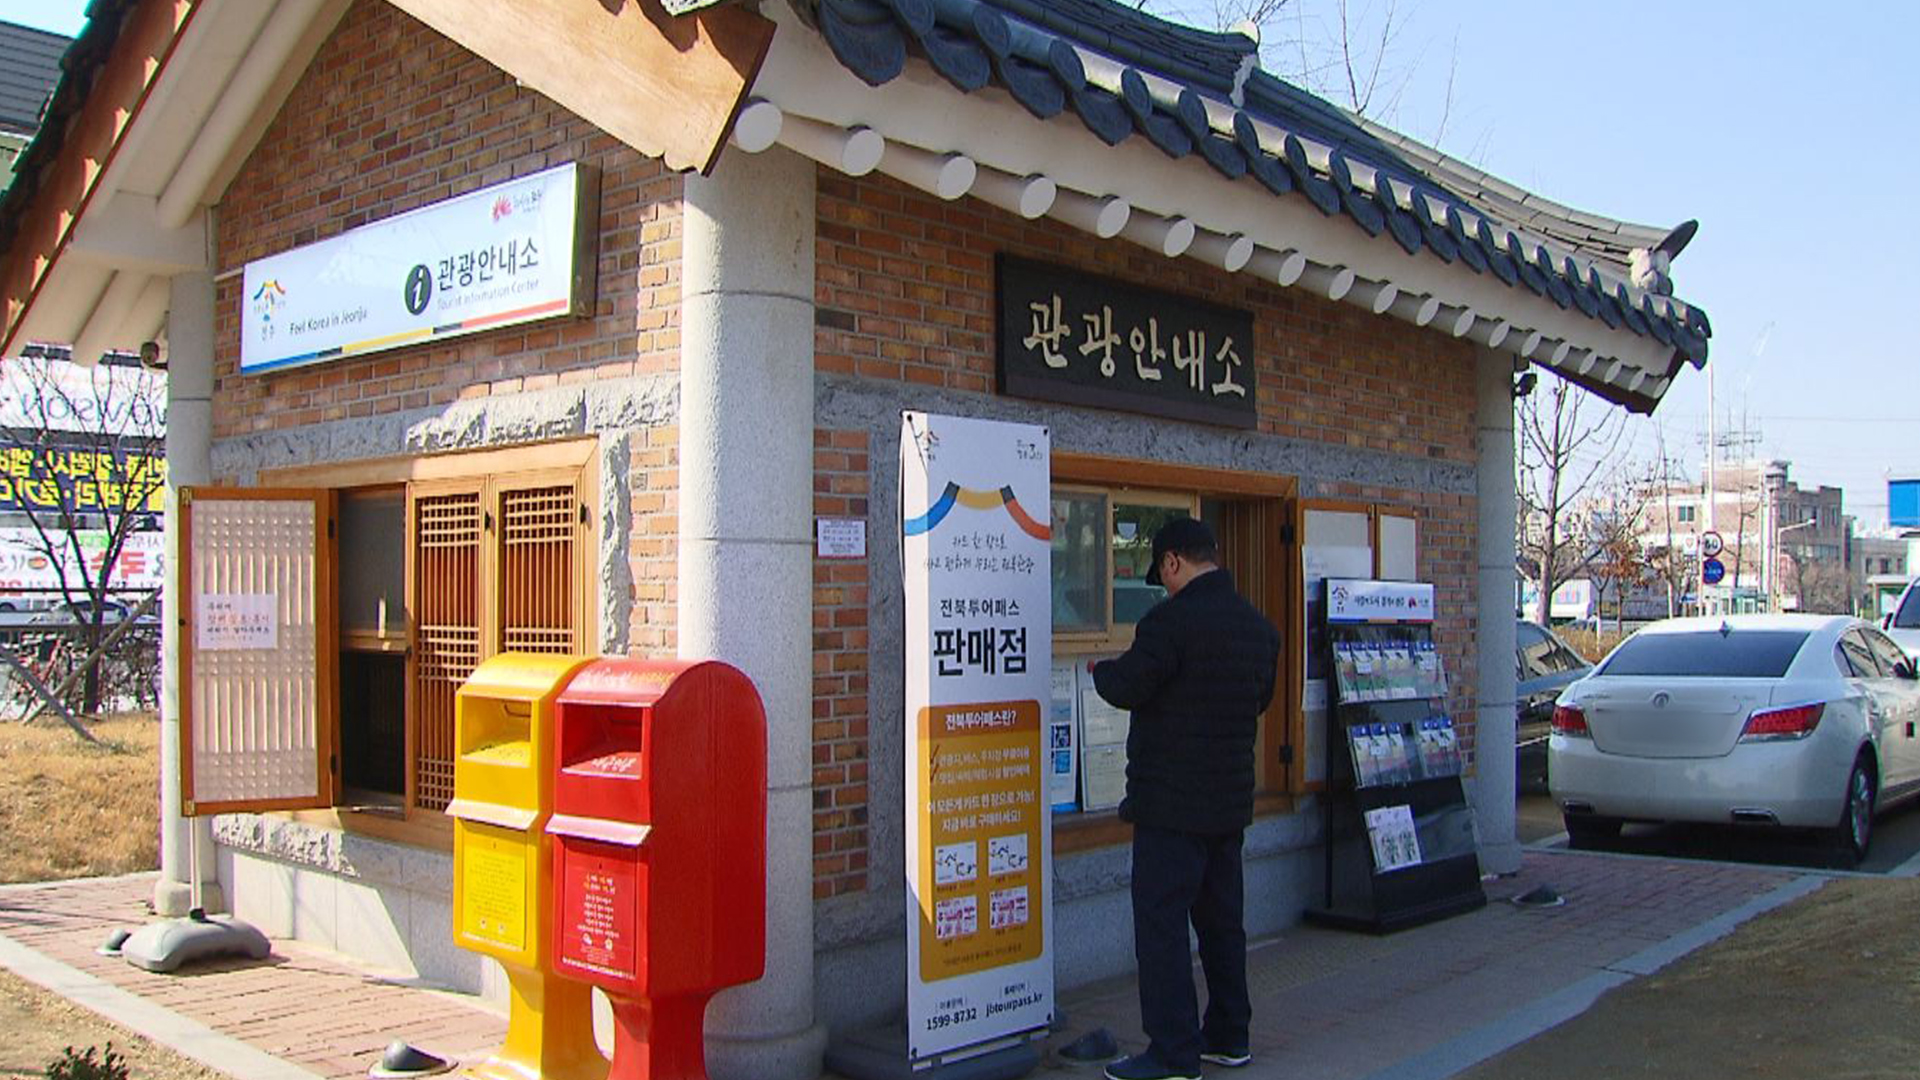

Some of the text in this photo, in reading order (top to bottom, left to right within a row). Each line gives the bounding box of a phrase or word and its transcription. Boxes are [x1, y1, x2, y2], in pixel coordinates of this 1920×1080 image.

[438, 237, 539, 292] 관광안내소
[464, 285, 510, 304] Information
[511, 278, 539, 294] Center
[289, 305, 368, 336] Feel Korea in Jeonju
[1022, 292, 1246, 398] 관광안내소
[940, 597, 1020, 618] 전북투어패스
[933, 626, 1028, 677] 판매점
[945, 709, 1017, 731] 전북투어패스란?
[986, 992, 1043, 1018] jbtourpass.kr
[927, 1007, 977, 1031] 1599-8732
